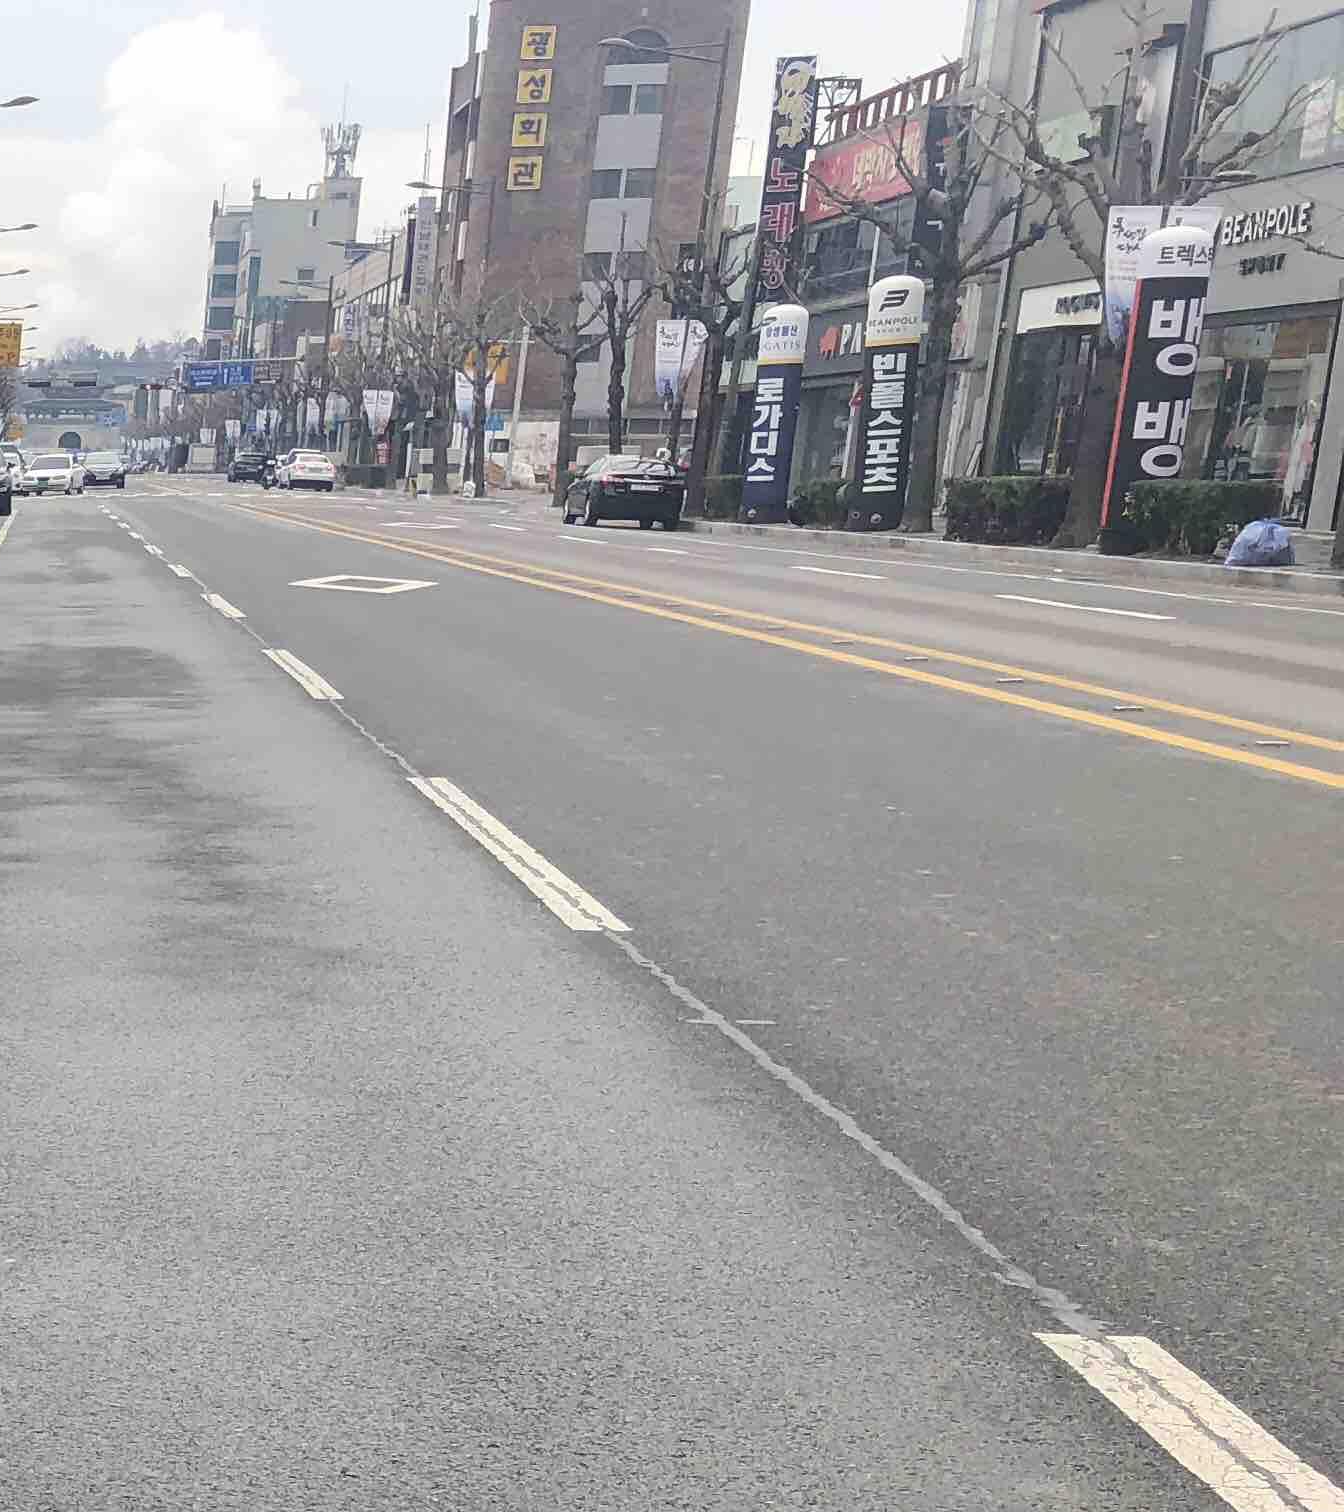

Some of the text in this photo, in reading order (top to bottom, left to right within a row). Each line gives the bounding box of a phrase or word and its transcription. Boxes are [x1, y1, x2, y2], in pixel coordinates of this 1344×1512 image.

[1220, 202, 1313, 246] BEANPOLE
[746, 377, 785, 482] 로가디스
[863, 352, 908, 493] 빈폴스포츠
[1132, 297, 1207, 477] 뱅뱅
